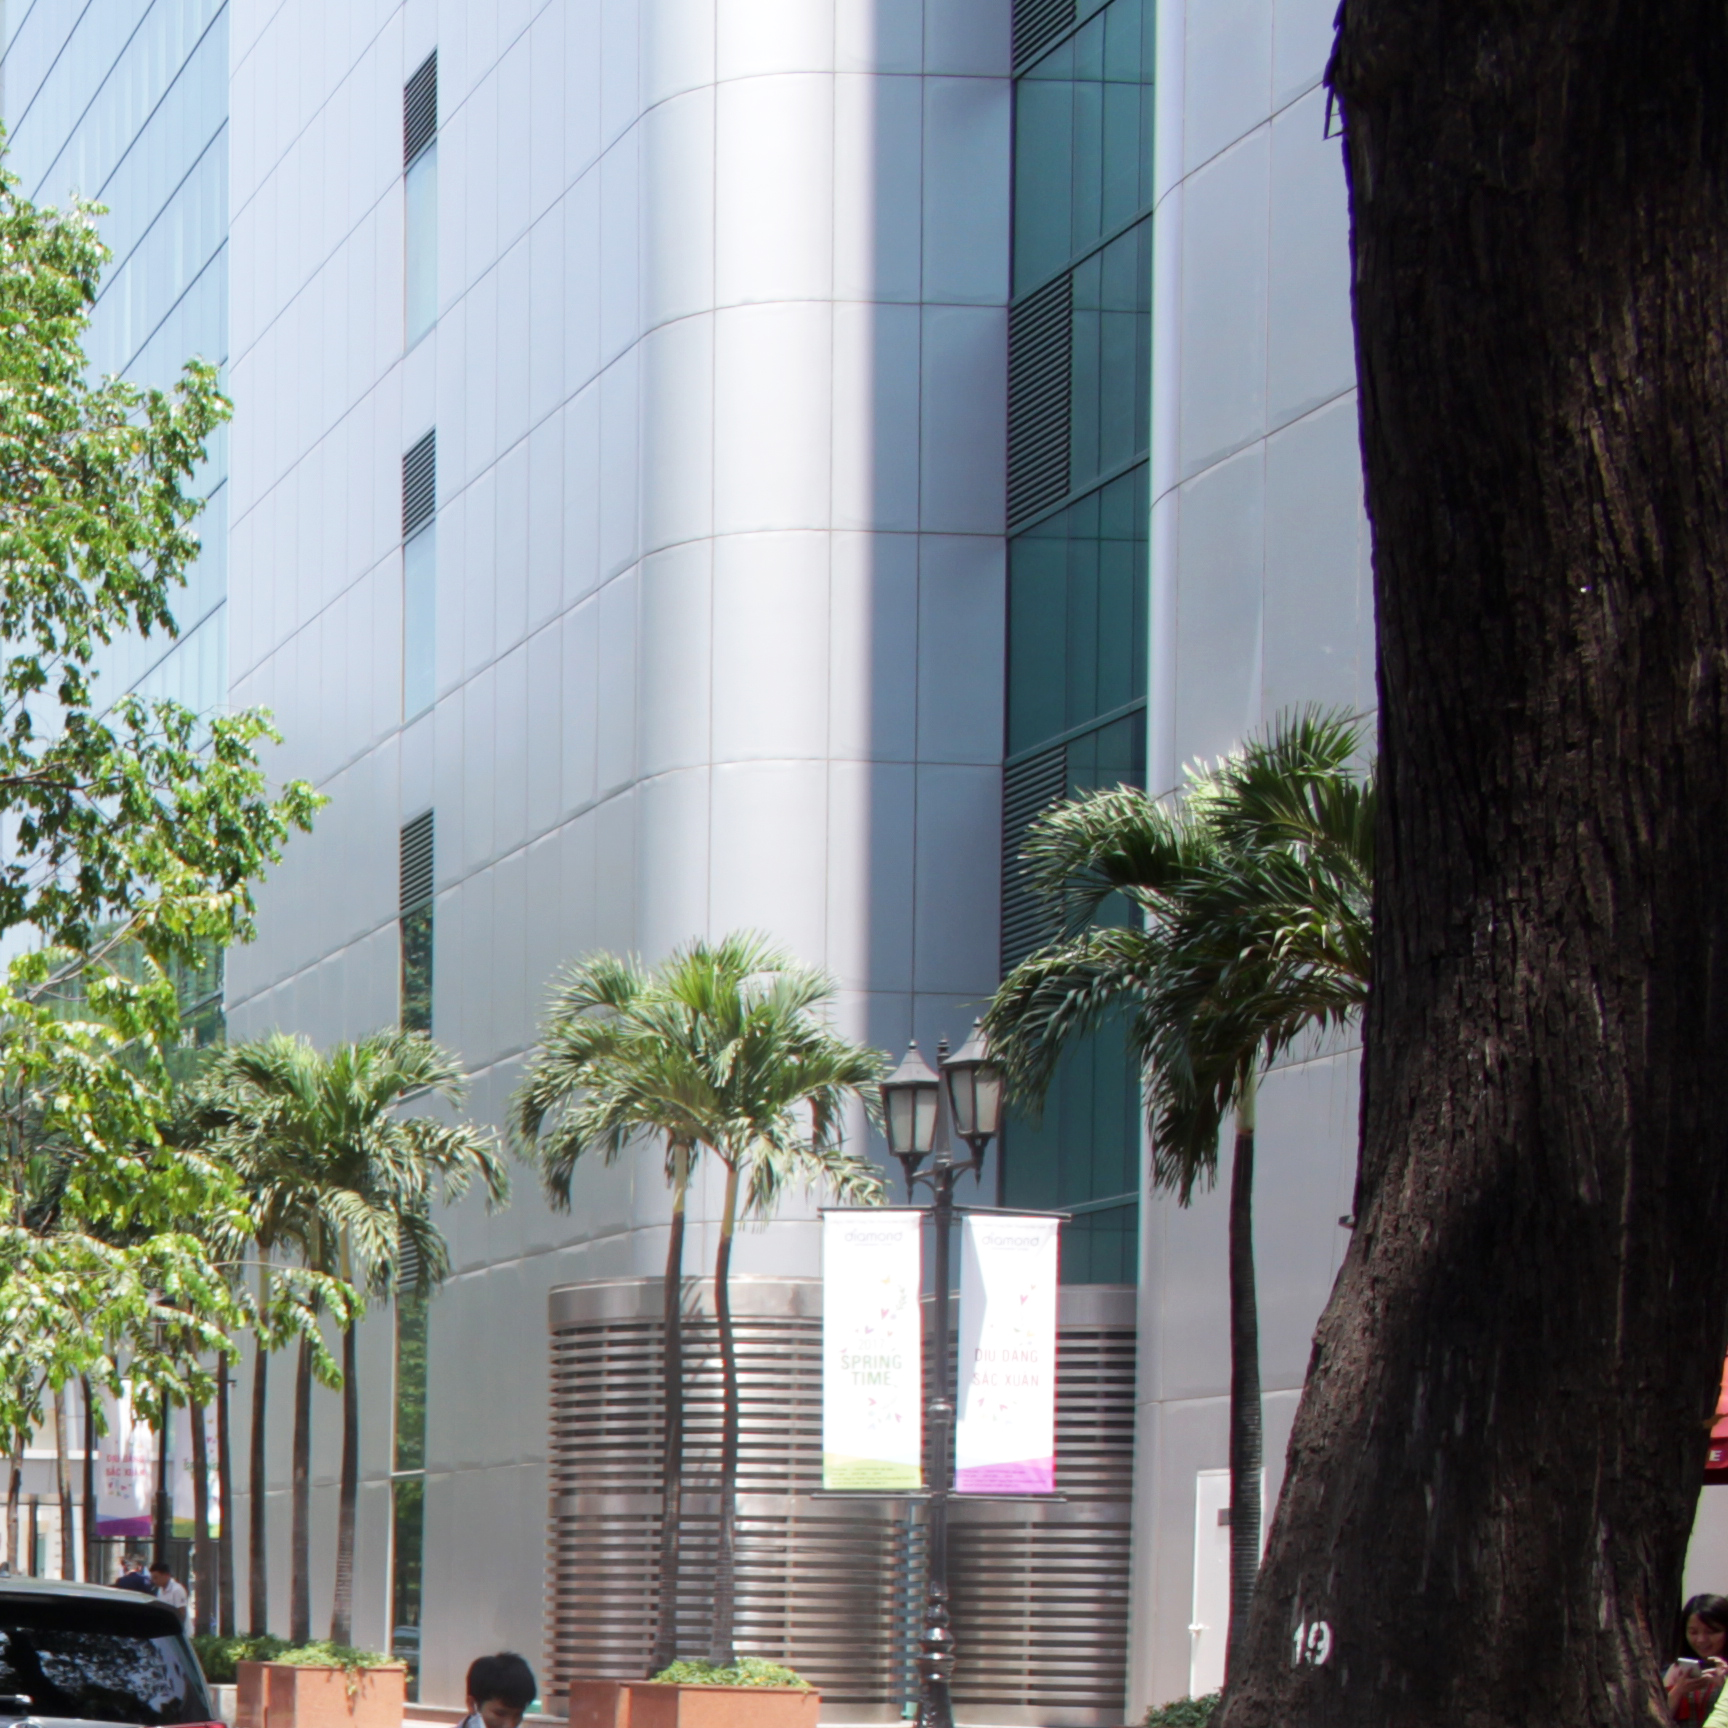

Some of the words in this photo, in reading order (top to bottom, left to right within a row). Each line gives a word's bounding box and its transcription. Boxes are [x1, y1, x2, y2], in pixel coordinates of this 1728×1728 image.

[845, 1229, 903, 1242] diamond
[982, 1233, 1040, 1247] diamond
[841, 1355, 902, 1370] SPRING
[852, 1371, 891, 1386] TIME
[1294, 1621, 1330, 1664] 19
